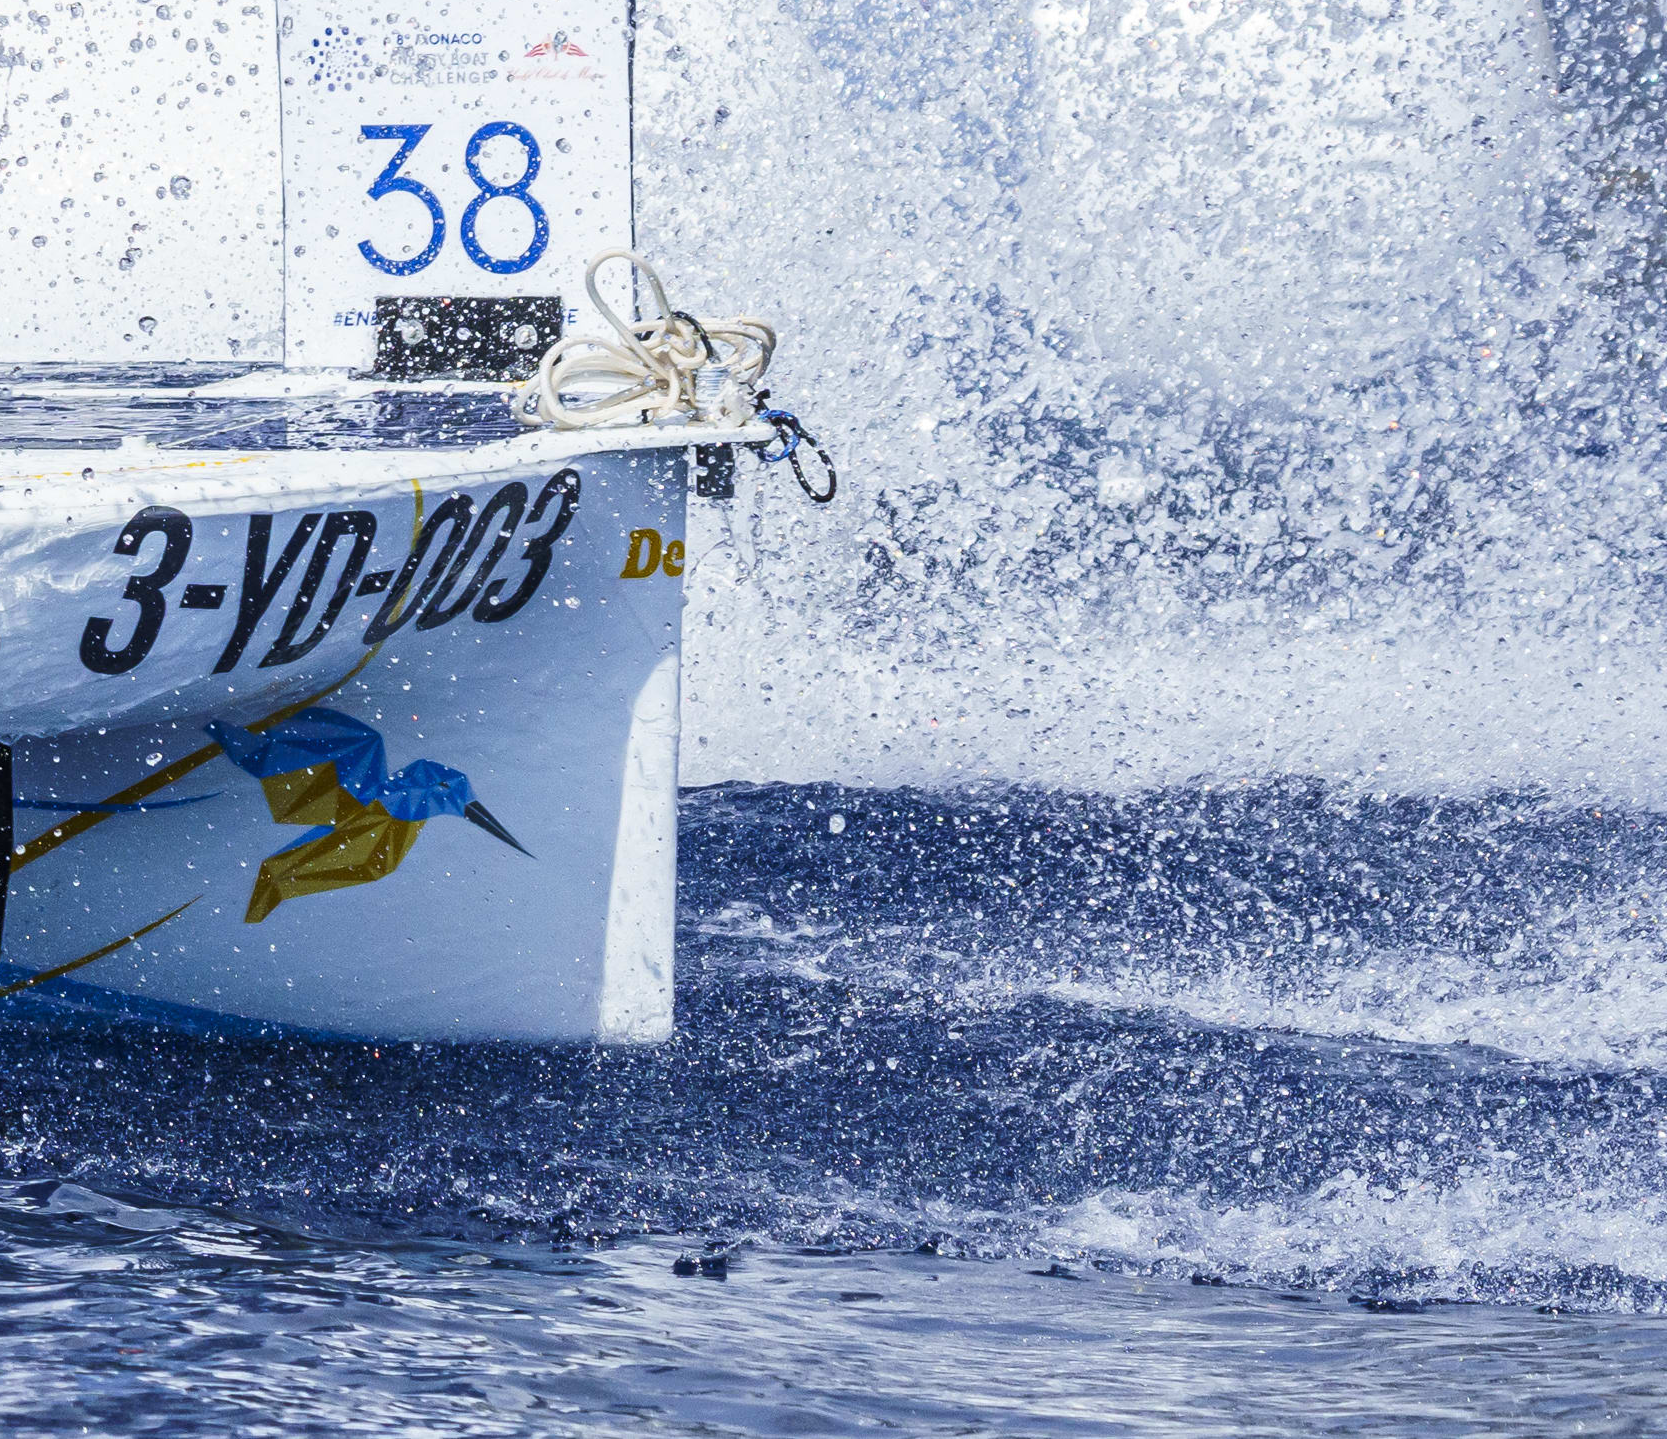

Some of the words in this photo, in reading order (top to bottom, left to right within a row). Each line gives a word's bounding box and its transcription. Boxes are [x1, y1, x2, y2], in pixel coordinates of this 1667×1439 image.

[390, 52, 446, 67] ENEGY
[357, 121, 550, 277] 38
[79, 468, 583, 675] 3-YD-003
